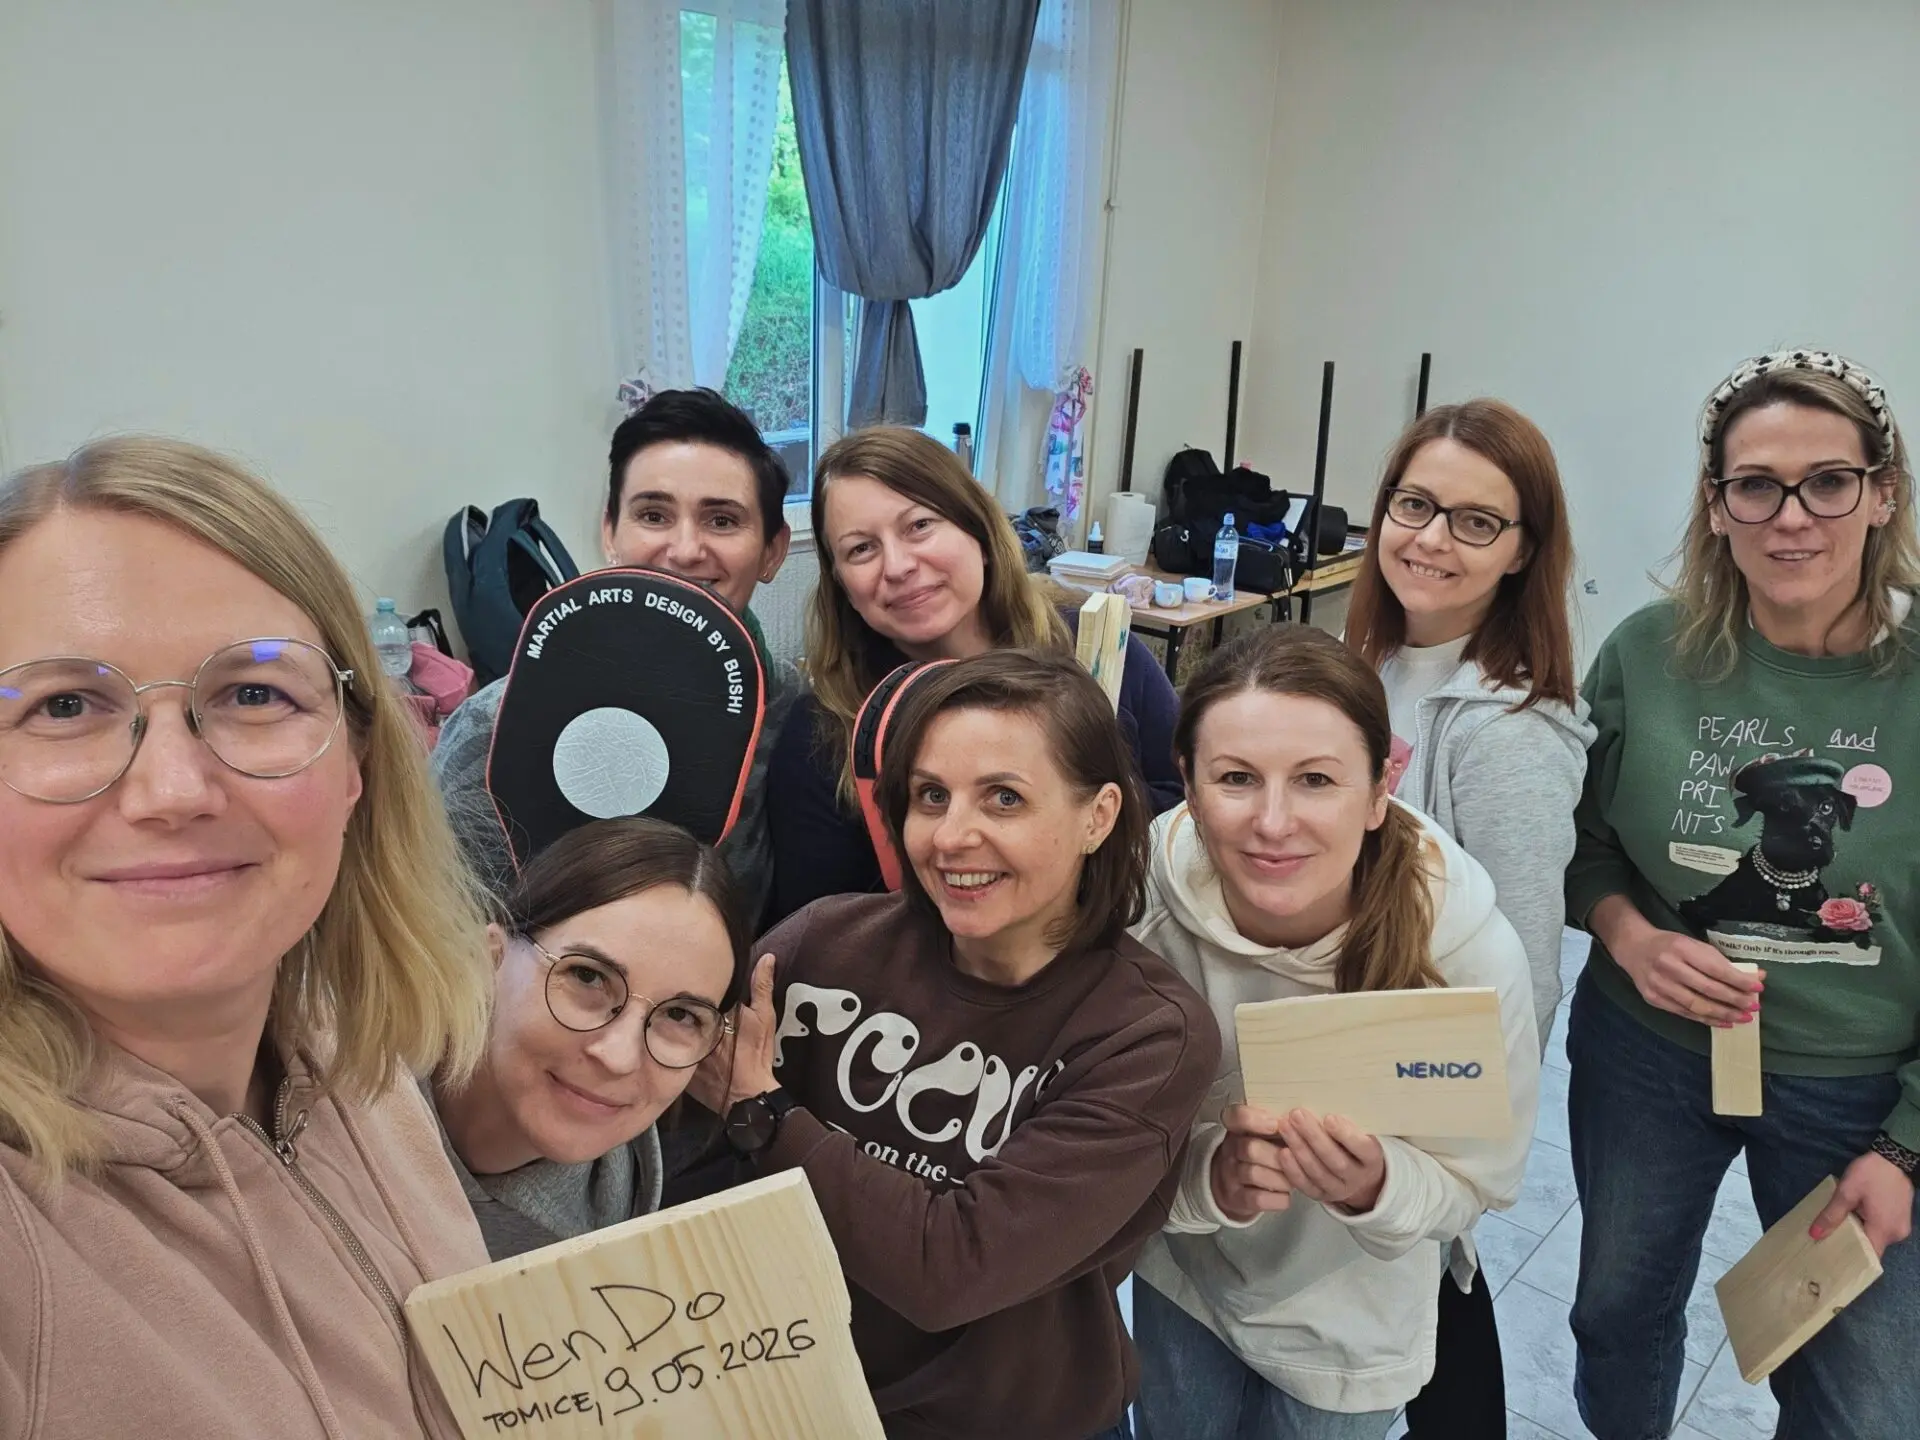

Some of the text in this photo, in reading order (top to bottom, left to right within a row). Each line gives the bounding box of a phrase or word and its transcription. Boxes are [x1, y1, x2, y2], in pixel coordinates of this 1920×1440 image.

[527, 588, 743, 714] MARTIAL ARTS DESIGN BY BUSHI
[1698, 716, 1877, 749] PEARLS and
[1689, 750, 1735, 777] PAW
[1680, 780, 1726, 808] PRI
[1671, 808, 1725, 834] NTS
[1396, 1062, 1482, 1079] WENDO
[864, 1141, 947, 1181] on the
[605, 1319, 816, 1416] 9.05.2026
